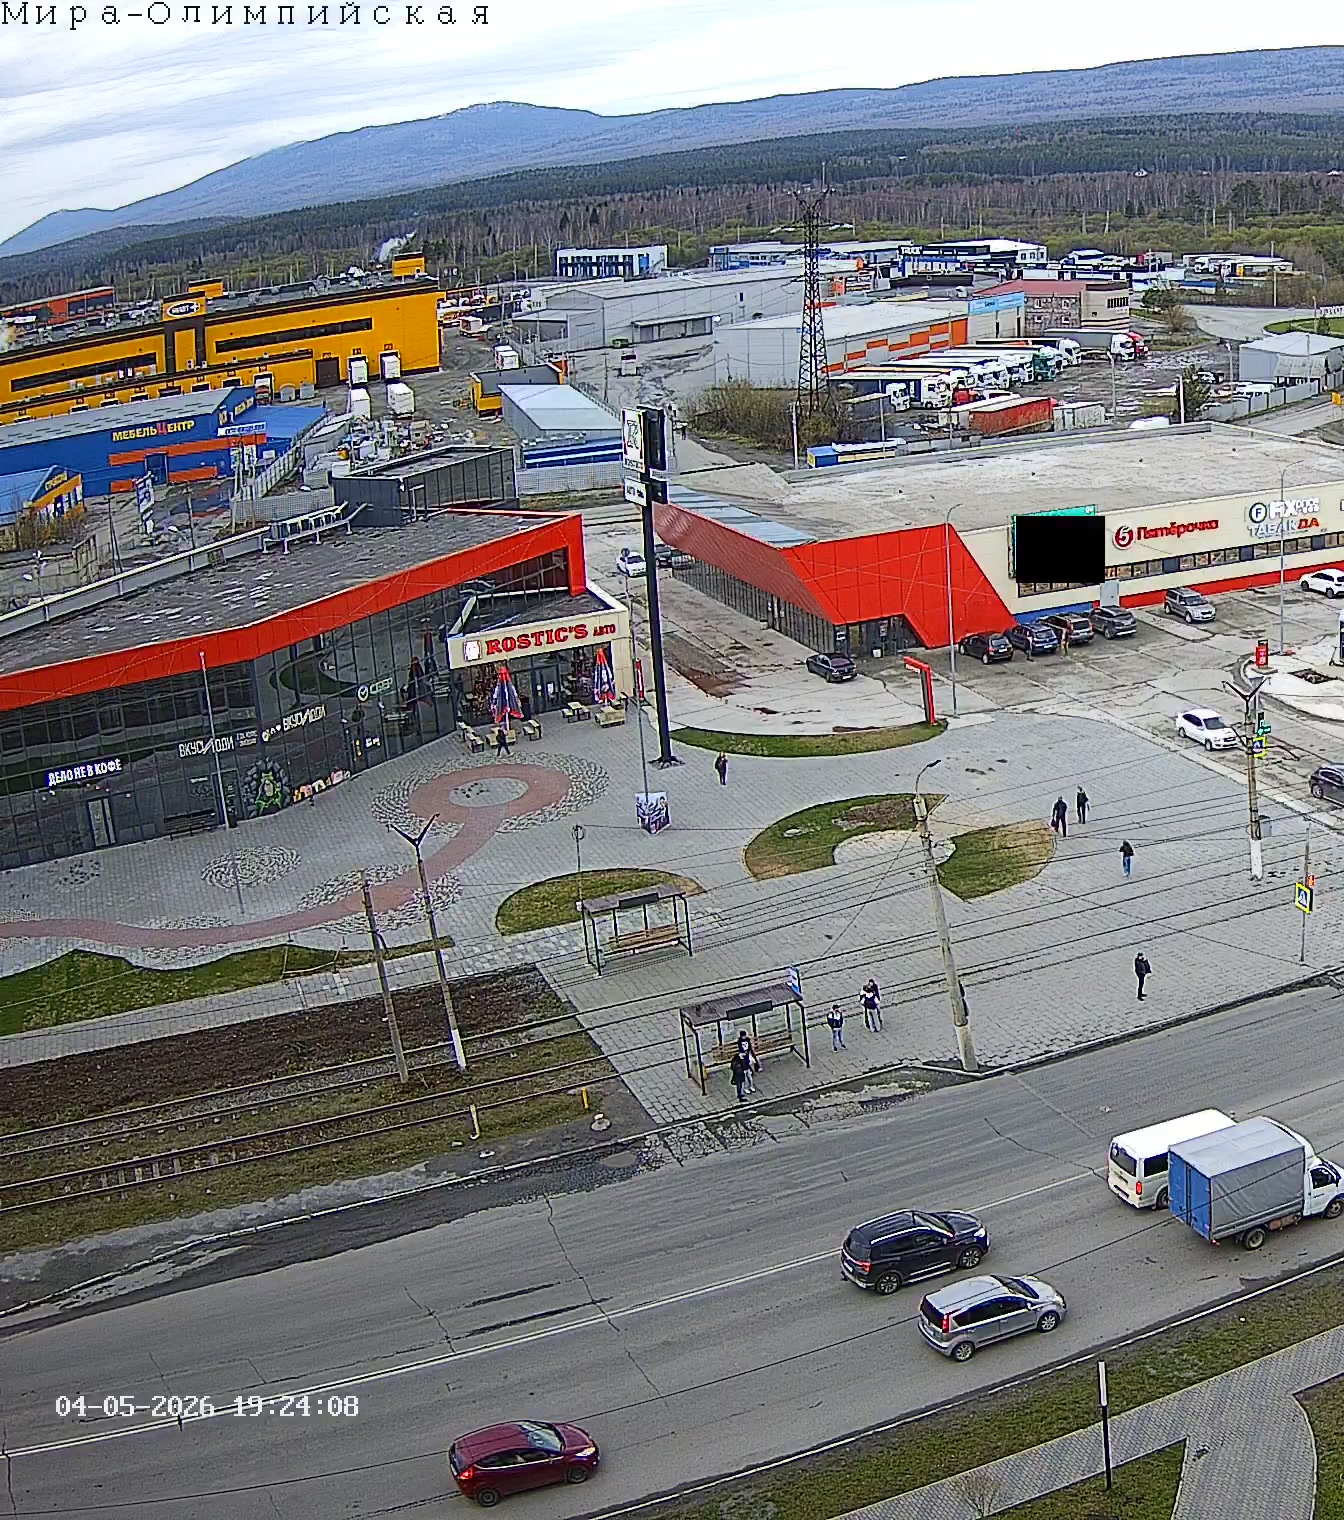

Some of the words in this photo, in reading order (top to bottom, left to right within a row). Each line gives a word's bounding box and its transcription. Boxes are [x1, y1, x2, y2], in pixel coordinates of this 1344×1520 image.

[486, 623, 589, 655] ROSTIC'S
[48, 768, 73, 787] ДЕЛО
[73, 765, 87, 780] НЕ
[87, 764, 94, 777] В
[94, 758, 122, 775] КОФЕ
